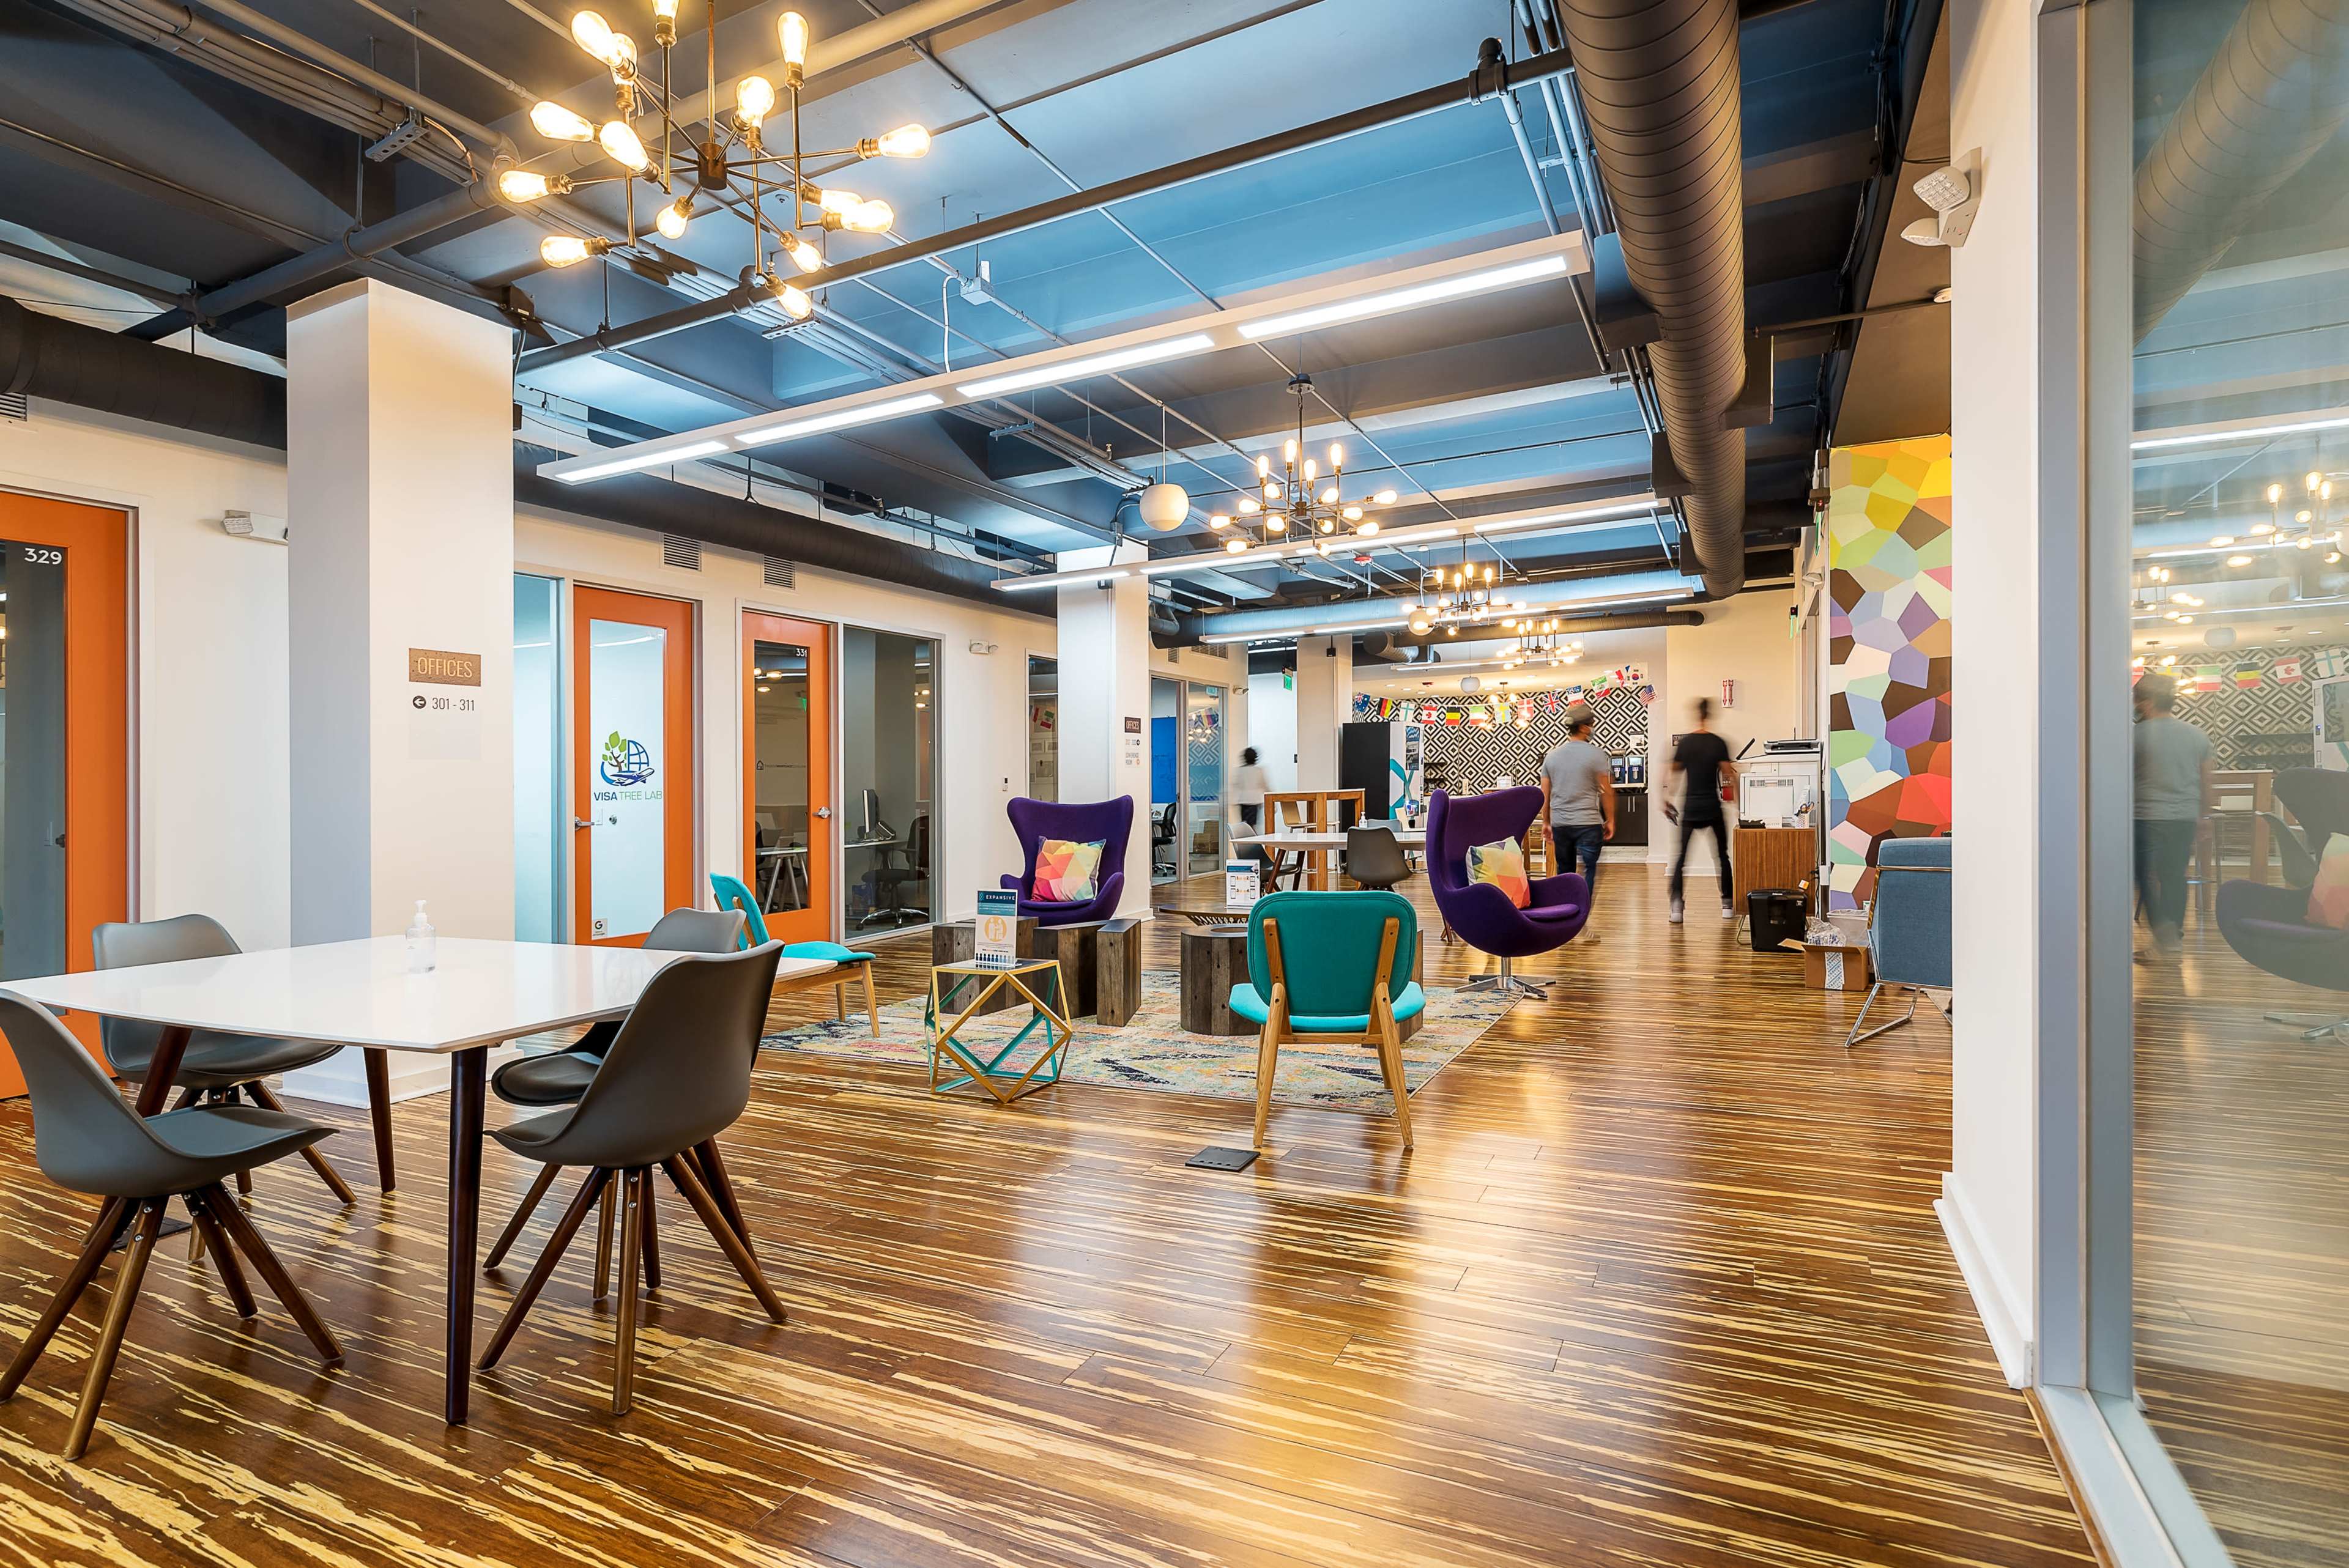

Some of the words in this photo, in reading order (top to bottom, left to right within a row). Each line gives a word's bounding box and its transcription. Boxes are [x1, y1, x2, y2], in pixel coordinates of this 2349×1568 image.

[24, 547, 62, 565] 329
[796, 648, 807, 657] 331
[418, 657, 472, 678] OFFICES
[432, 697, 450, 710] 301
[459, 699, 475, 711] 311
[594, 792, 617, 801] VISA
[619, 791, 642, 801] TREE
[645, 791, 662, 800] LAB
[595, 920, 603, 930] G
